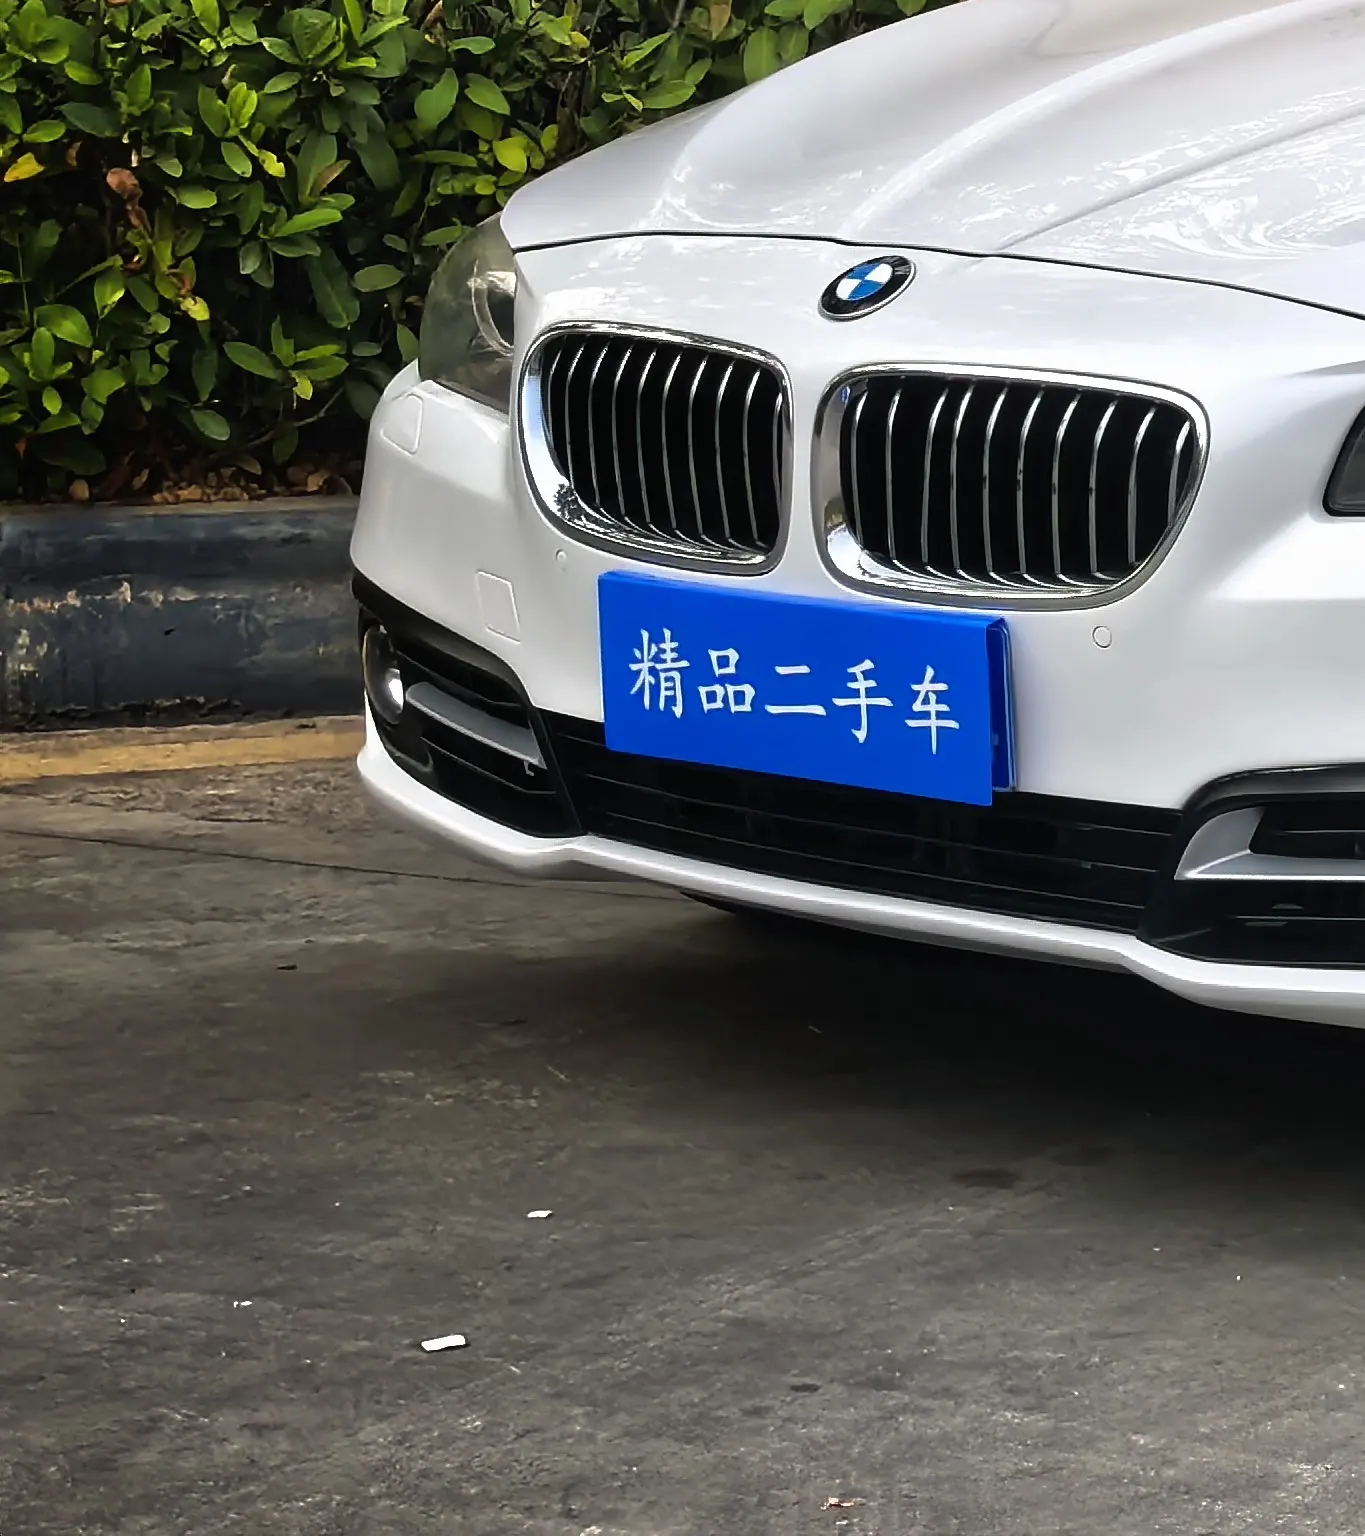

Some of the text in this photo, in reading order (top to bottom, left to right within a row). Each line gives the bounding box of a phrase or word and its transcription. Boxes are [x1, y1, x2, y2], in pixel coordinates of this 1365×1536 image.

[628, 627, 961, 756] 精品二手车
